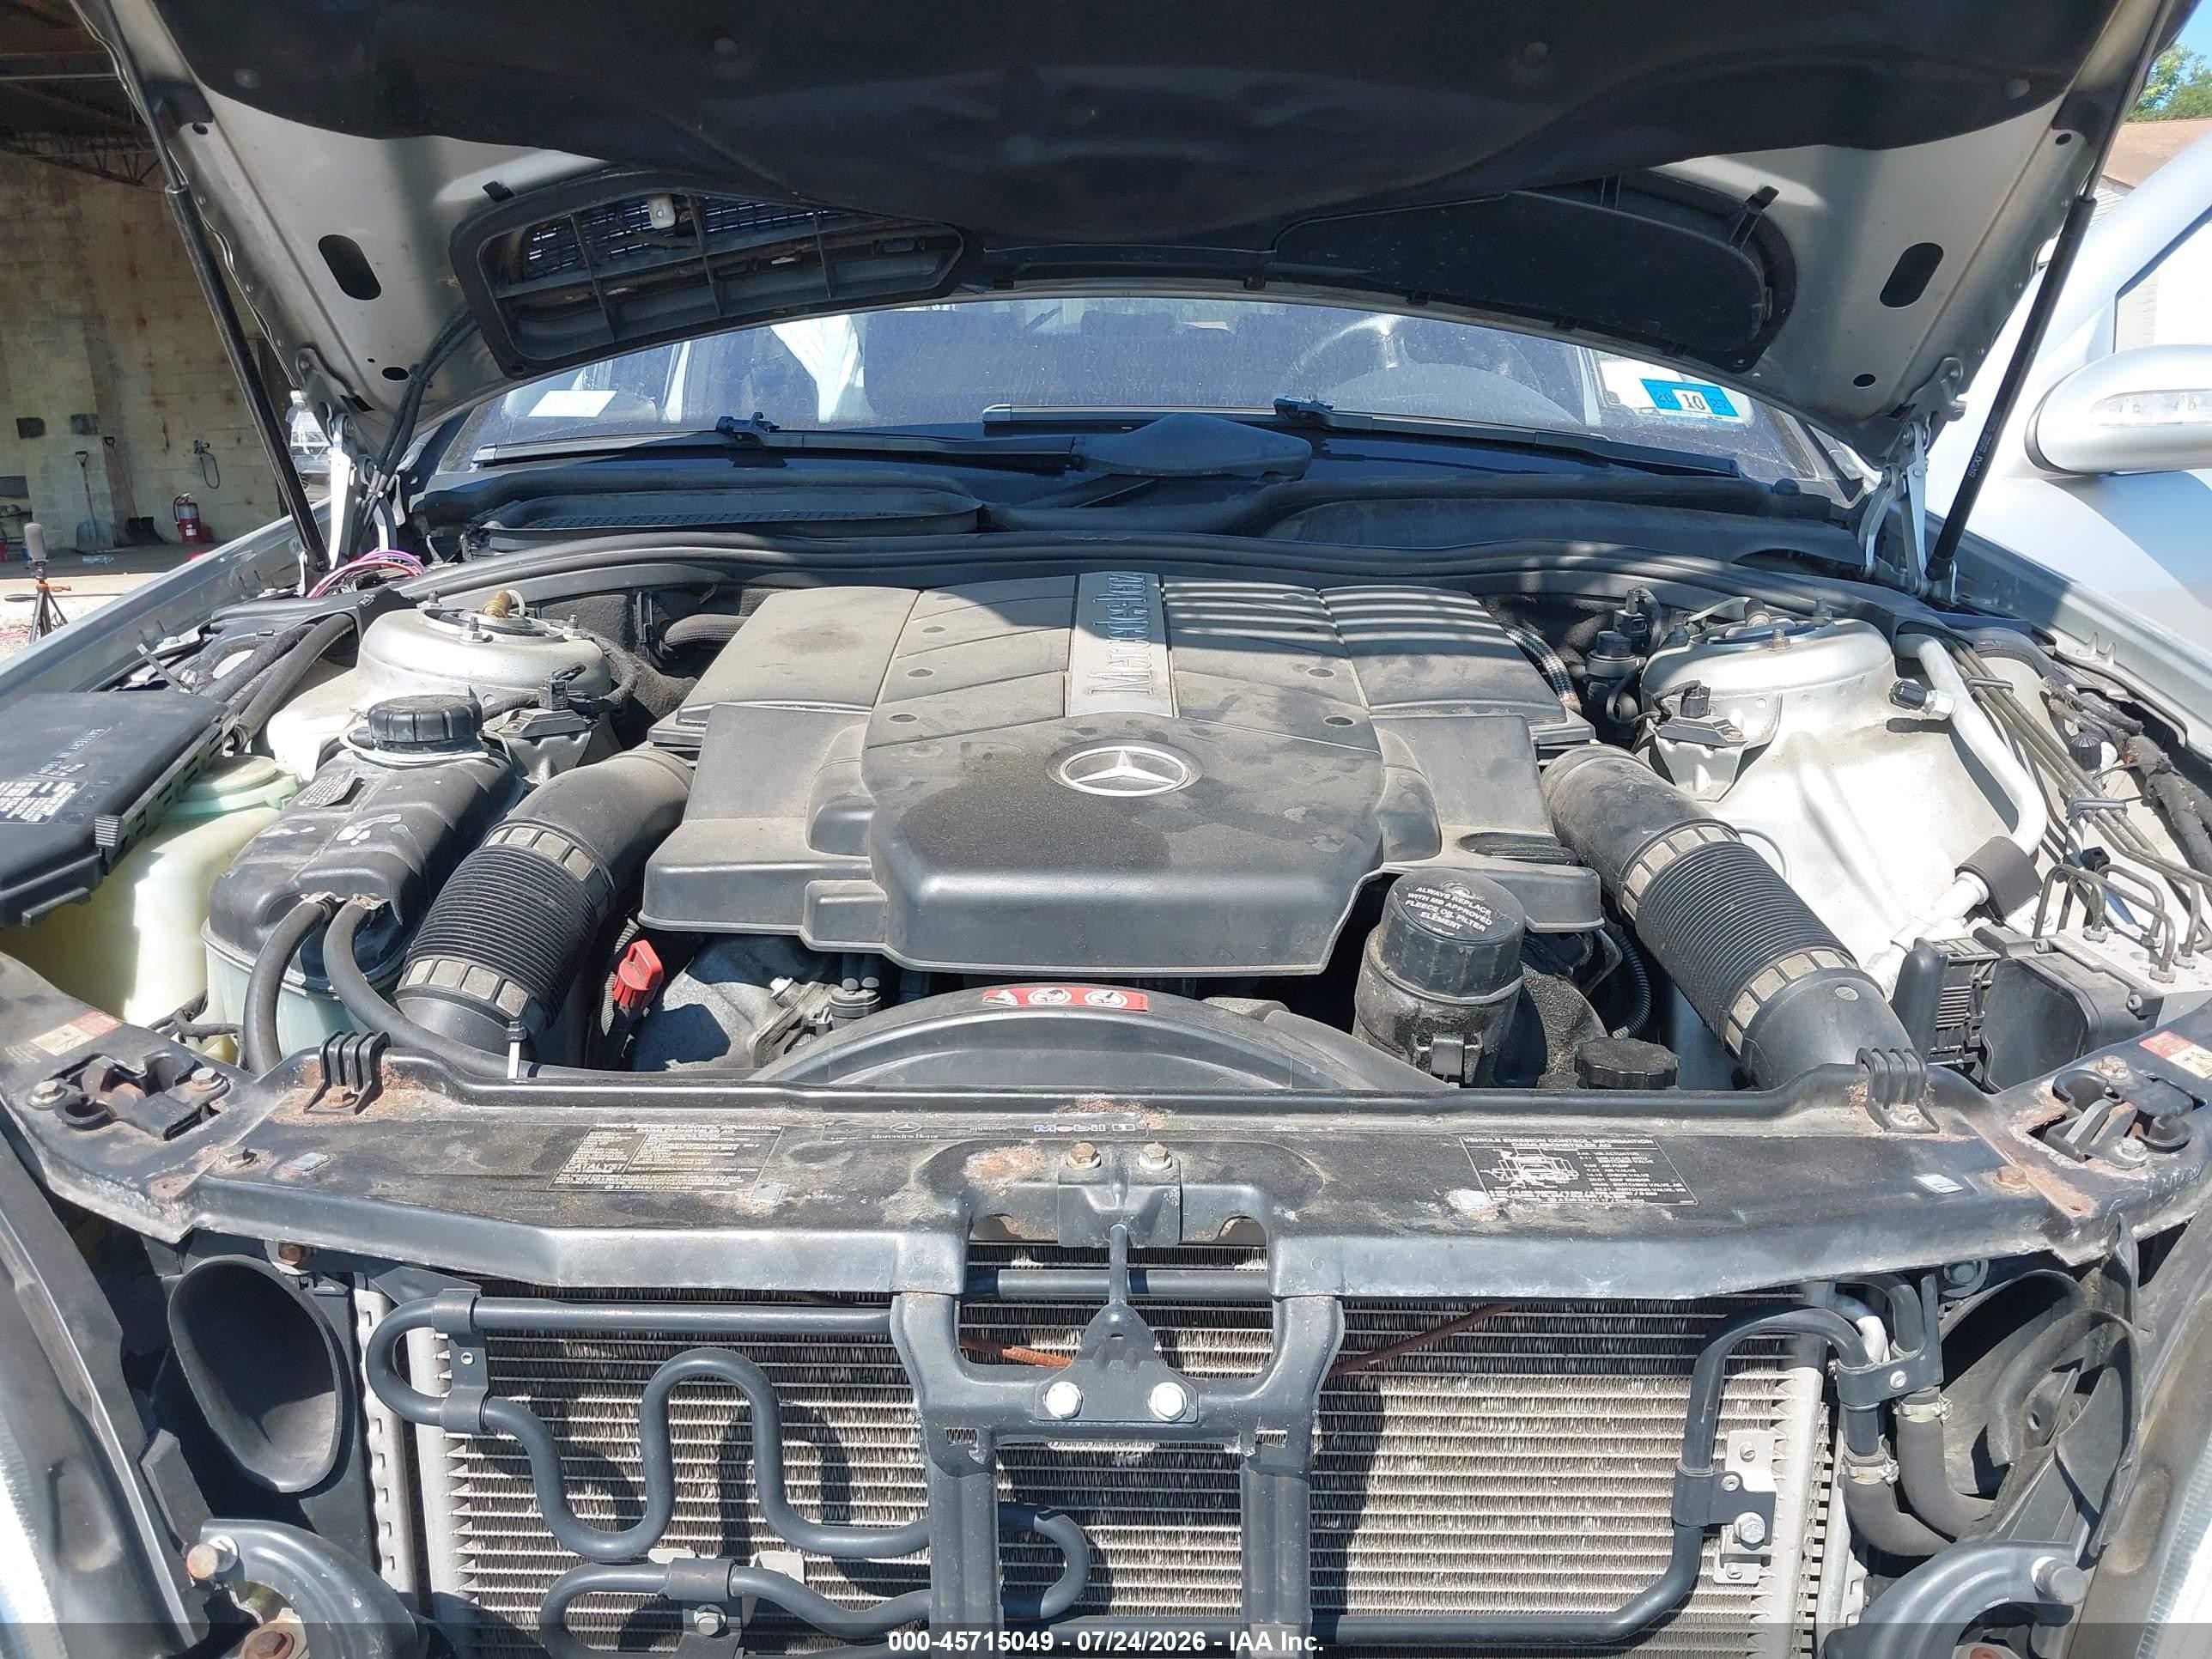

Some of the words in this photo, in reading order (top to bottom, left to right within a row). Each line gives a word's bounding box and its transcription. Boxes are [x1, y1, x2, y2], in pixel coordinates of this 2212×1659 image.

[1681, 393, 1706, 410] 10
[1087, 573, 1153, 696] Mercedes-Benz
[1405, 899, 1440, 913] FLEECE
[1440, 908, 1455, 919] OIL
[1455, 914, 1486, 933] FILTER
[1407, 892, 1431, 902] WITH
[1445, 902, 1492, 926] APPROVED
[1415, 886, 1451, 900] ALWAYS
[1451, 896, 1492, 916] REPLACE
[1419, 911, 1463, 930] ELEMENT
